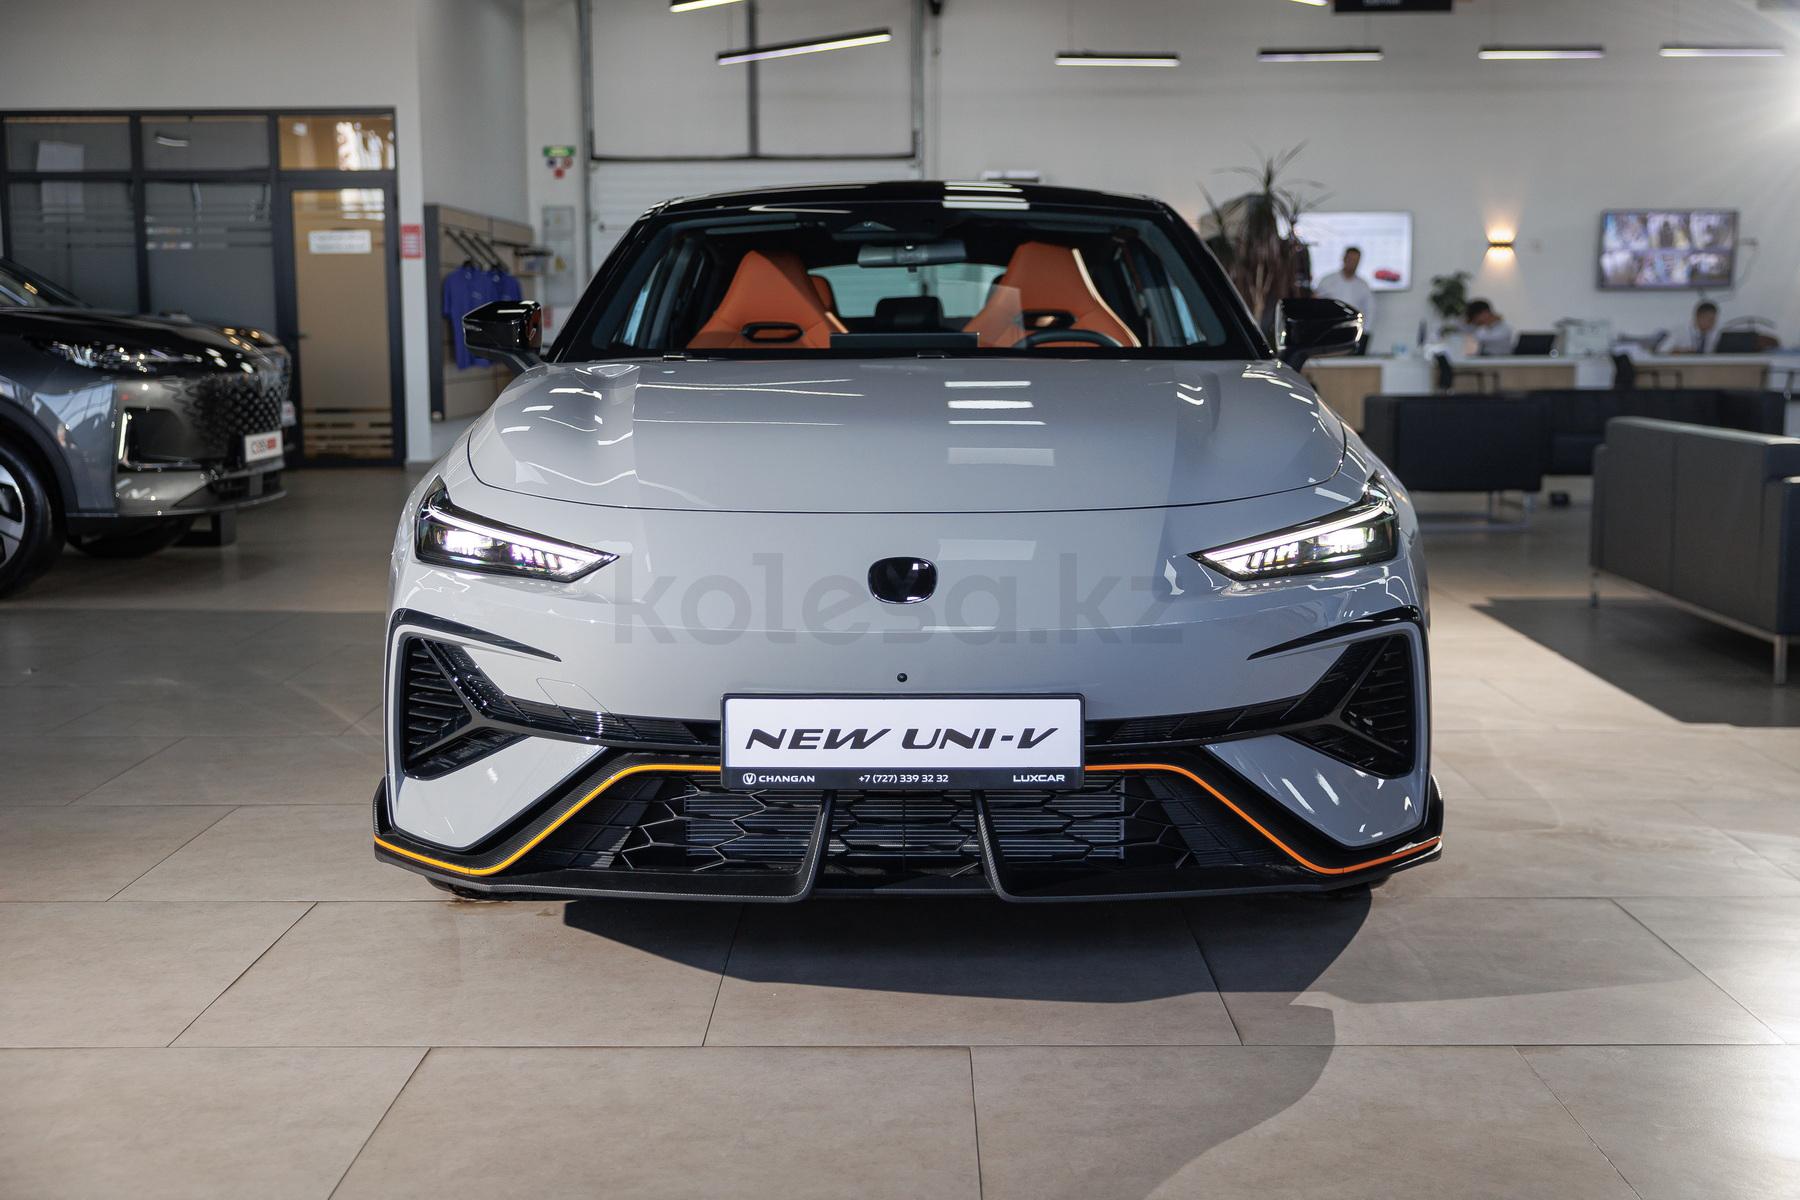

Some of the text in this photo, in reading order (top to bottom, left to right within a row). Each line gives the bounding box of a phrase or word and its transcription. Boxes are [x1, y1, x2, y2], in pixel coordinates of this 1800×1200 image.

[745, 728, 1058, 750] NEW UNI-V
[758, 774, 815, 783] CHANGAN
[858, 774, 949, 785] +7 (727) 339 32 32
[1013, 774, 1065, 783] LUXCAR
